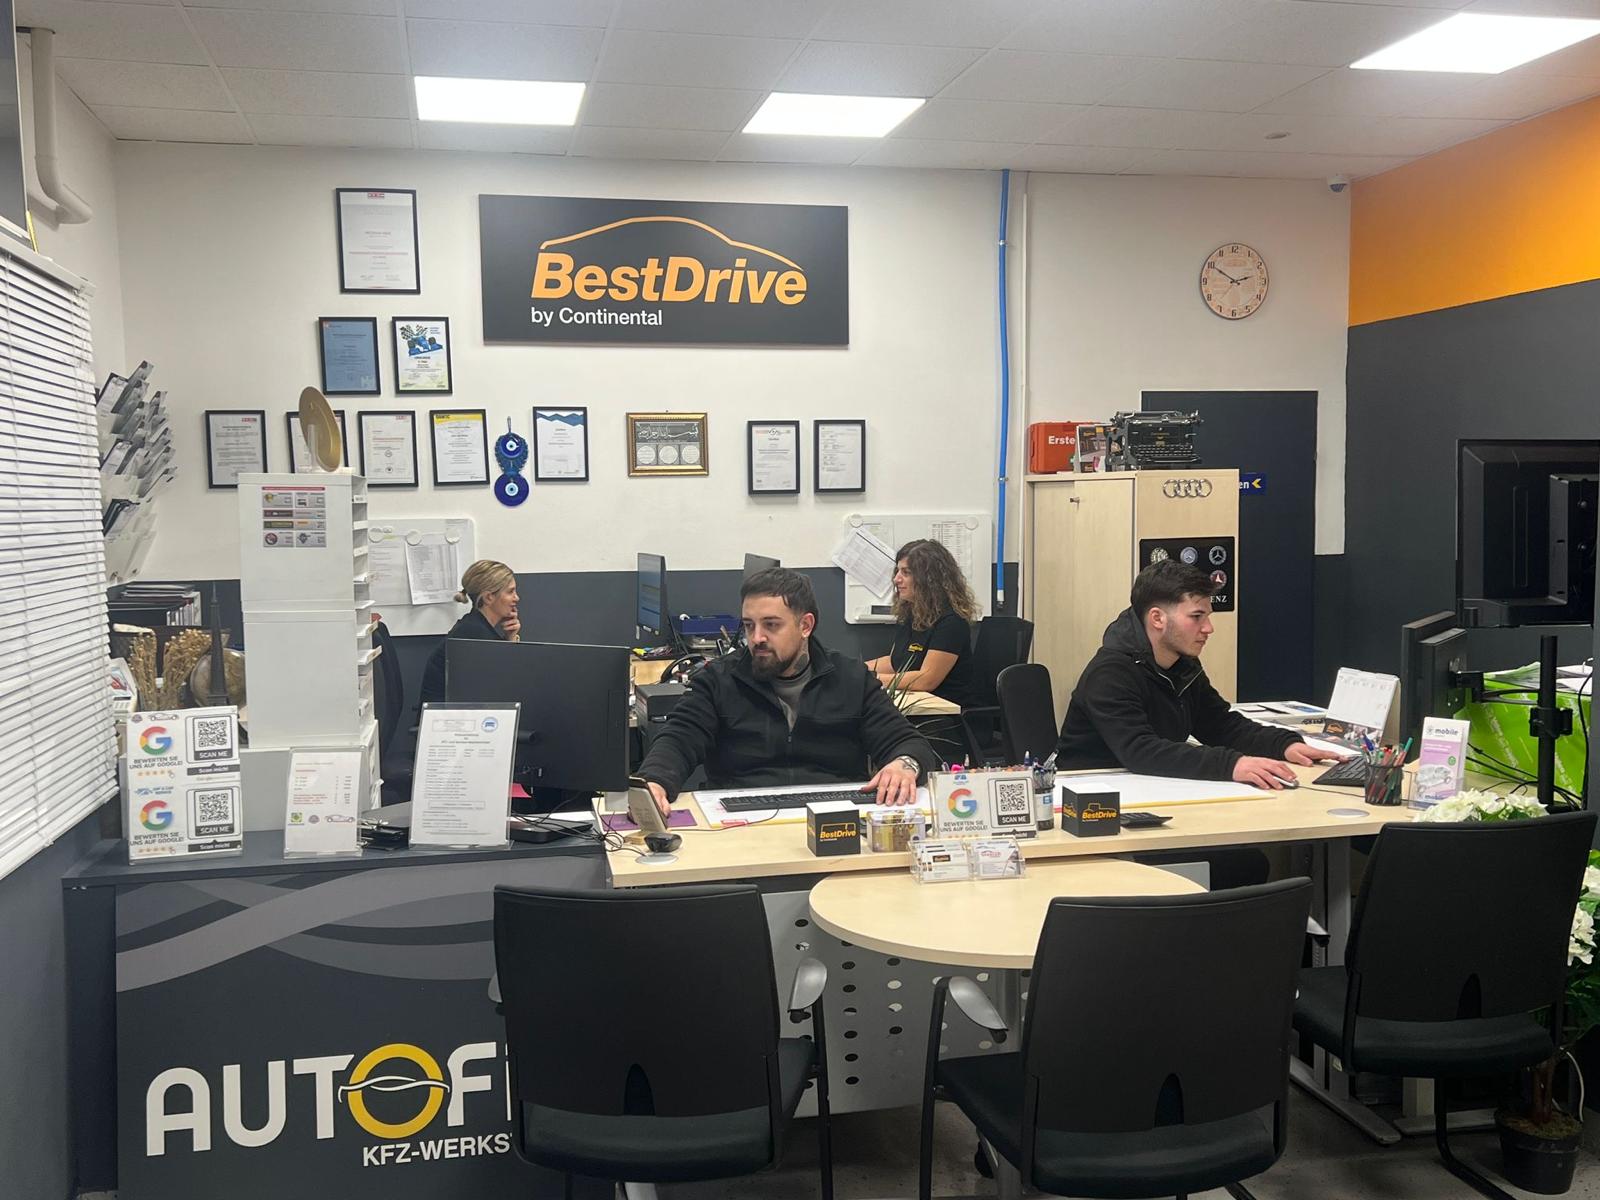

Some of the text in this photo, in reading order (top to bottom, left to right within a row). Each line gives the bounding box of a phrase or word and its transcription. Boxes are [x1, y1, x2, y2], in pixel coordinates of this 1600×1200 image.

[530, 252, 808, 305] BestDrive
[531, 307, 663, 327] by Continental
[1048, 435, 1075, 445] Erste
[1239, 481, 1249, 489] en
[1210, 595, 1227, 603] ENZ
[1082, 811, 1117, 819] BestDrive
[820, 829, 856, 839] BestDrive
[362, 1132, 512, 1167] KFZ-WERKS
